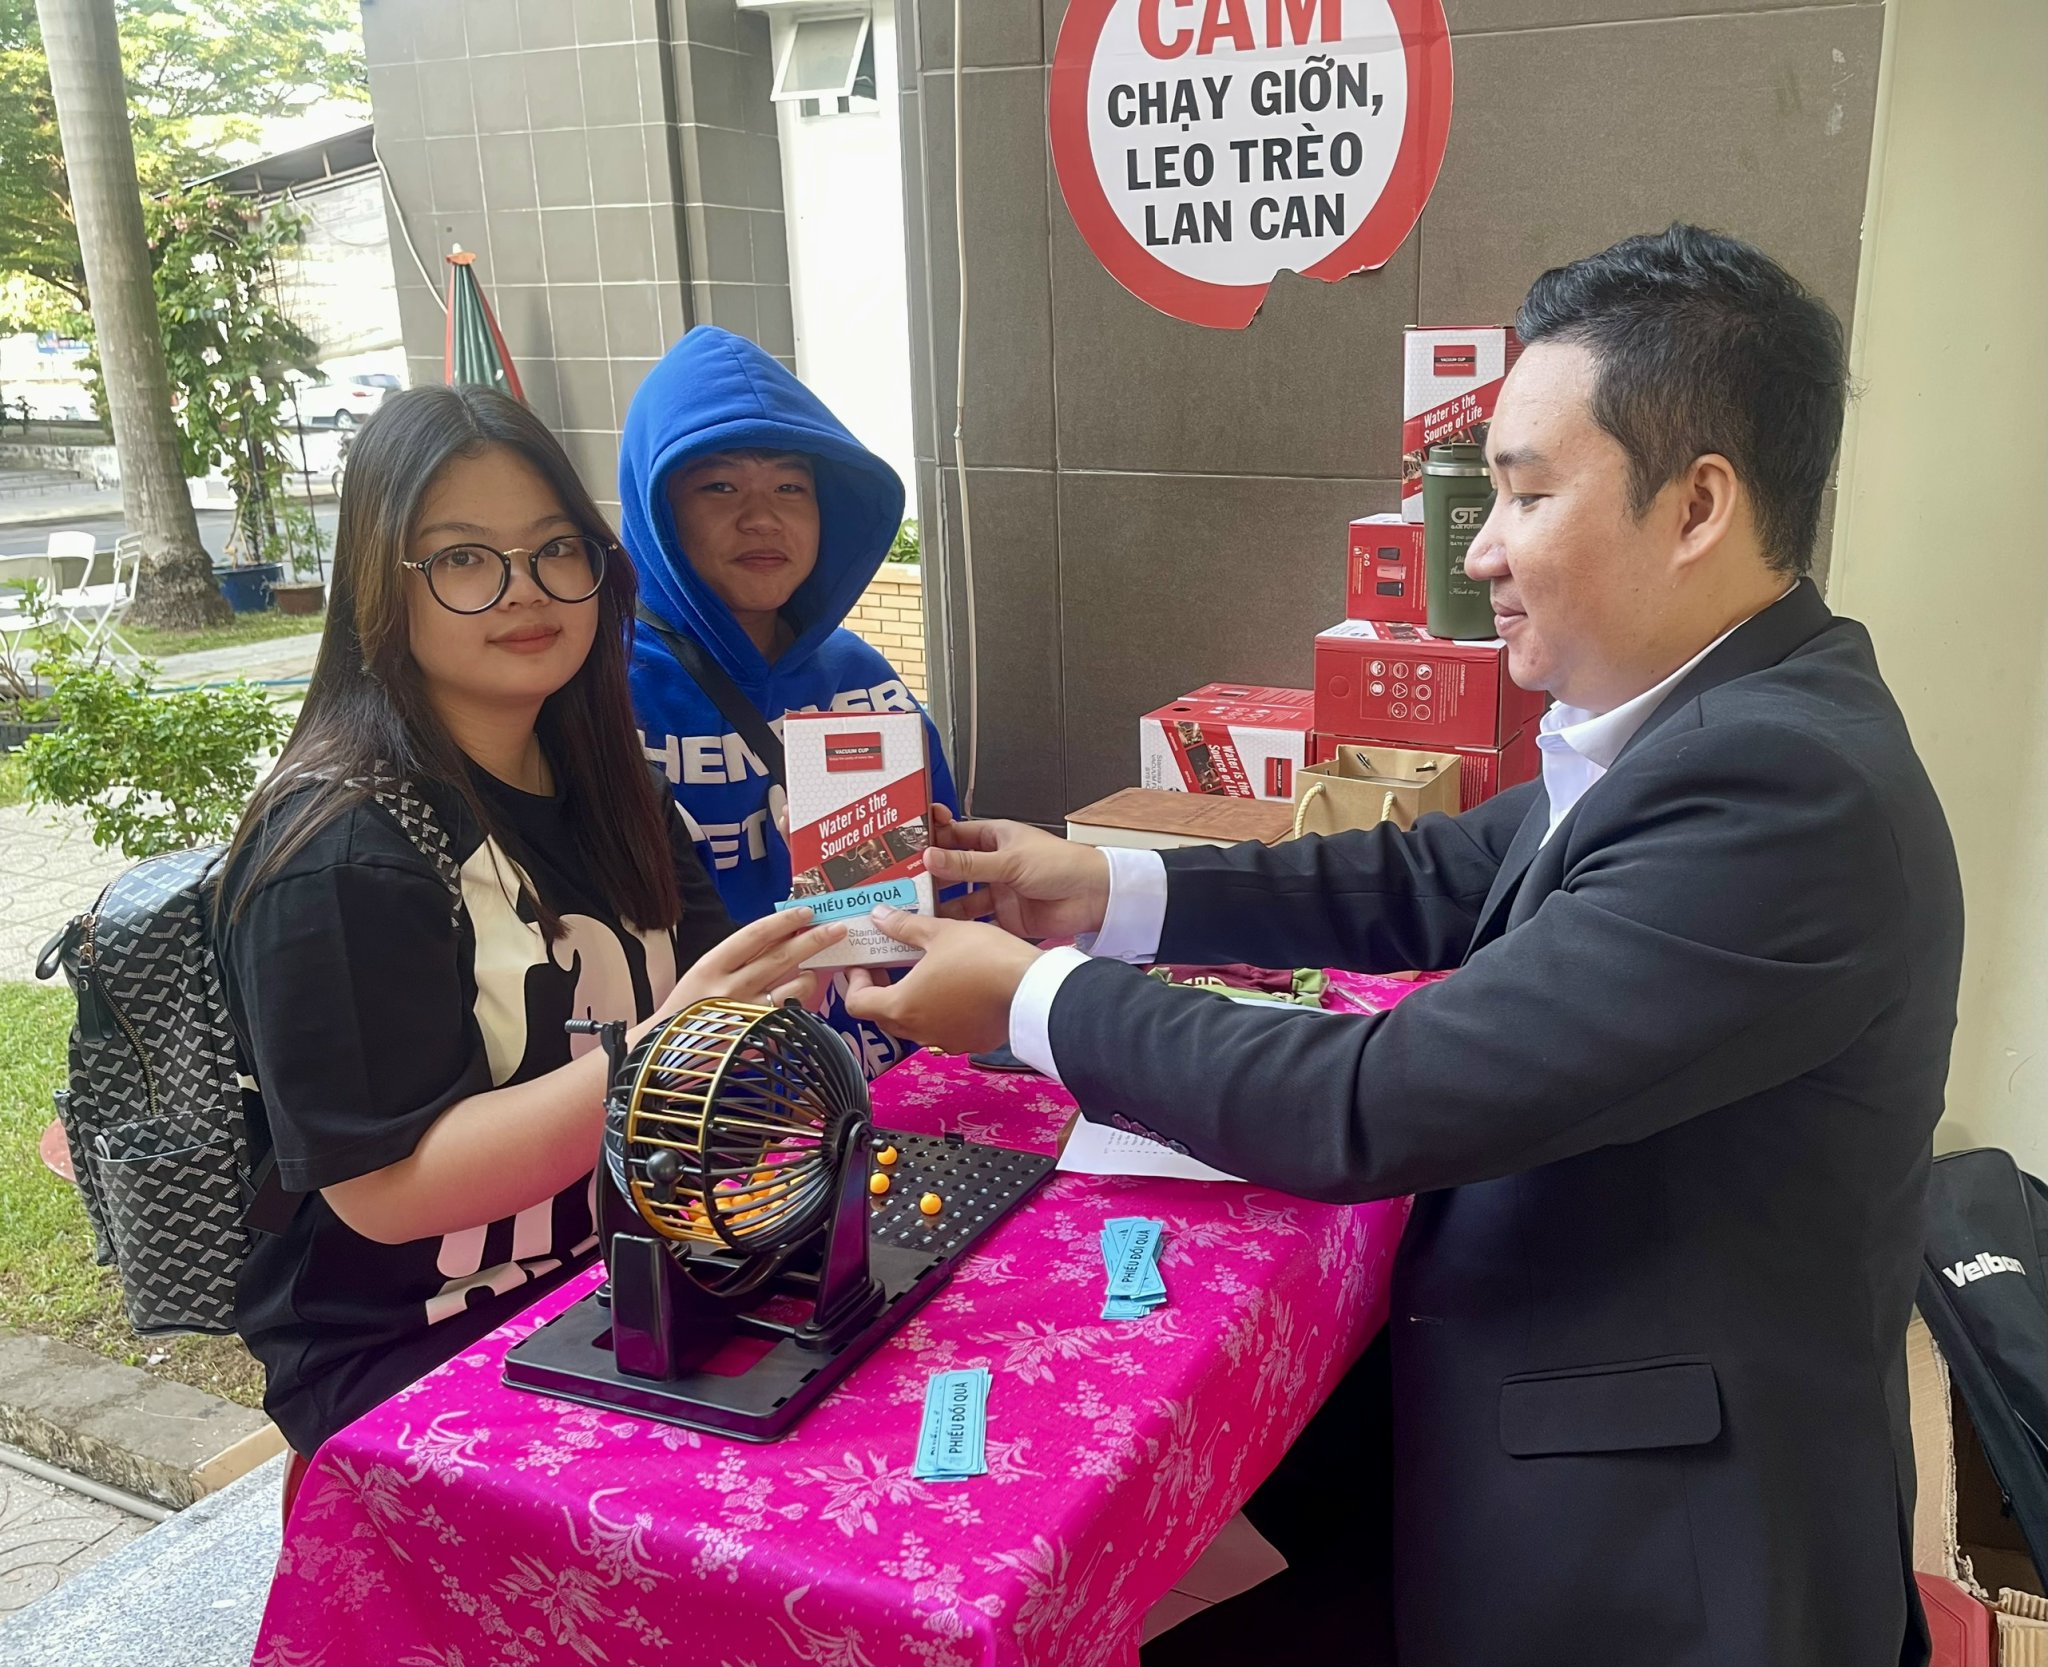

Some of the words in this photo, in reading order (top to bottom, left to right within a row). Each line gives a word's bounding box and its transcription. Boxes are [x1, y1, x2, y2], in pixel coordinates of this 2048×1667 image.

[1107, 74, 1233, 131] CHẠY
[1251, 54, 1383, 117] GIỠN,
[1127, 143, 1214, 190] LEO
[1230, 123, 1363, 183] TRÈO
[1145, 200, 1232, 246] LAN
[1250, 193, 1345, 241] CAN
[1424, 406, 1449, 428] Water
[1451, 402, 1459, 415] is
[1461, 394, 1476, 410] the
[1424, 421, 1453, 444] Source
[1455, 412, 1464, 429] of
[1466, 405, 1483, 424] Life
[1451, 507, 1483, 524] GF
[1208, 744, 1225, 773] Source
[1220, 774, 1234, 784] of
[1221, 745, 1240, 771] Water
[1233, 771, 1243, 780] is
[1238, 780, 1250, 796] the
[818, 811, 852, 840] Water
[855, 804, 866, 820] is
[868, 793, 888, 813] the
[821, 830, 860, 860] Source
[863, 818, 875, 838] of
[877, 807, 898, 829] Life
[873, 886, 902, 903] QUÀ
[848, 928, 882, 938] Stainle
[849, 937, 889, 946] VACUUM
[870, 946, 888, 955] BYS
[1942, 1252, 2027, 1288] Velbon
[952, 1381, 969, 1402] QUÀ
